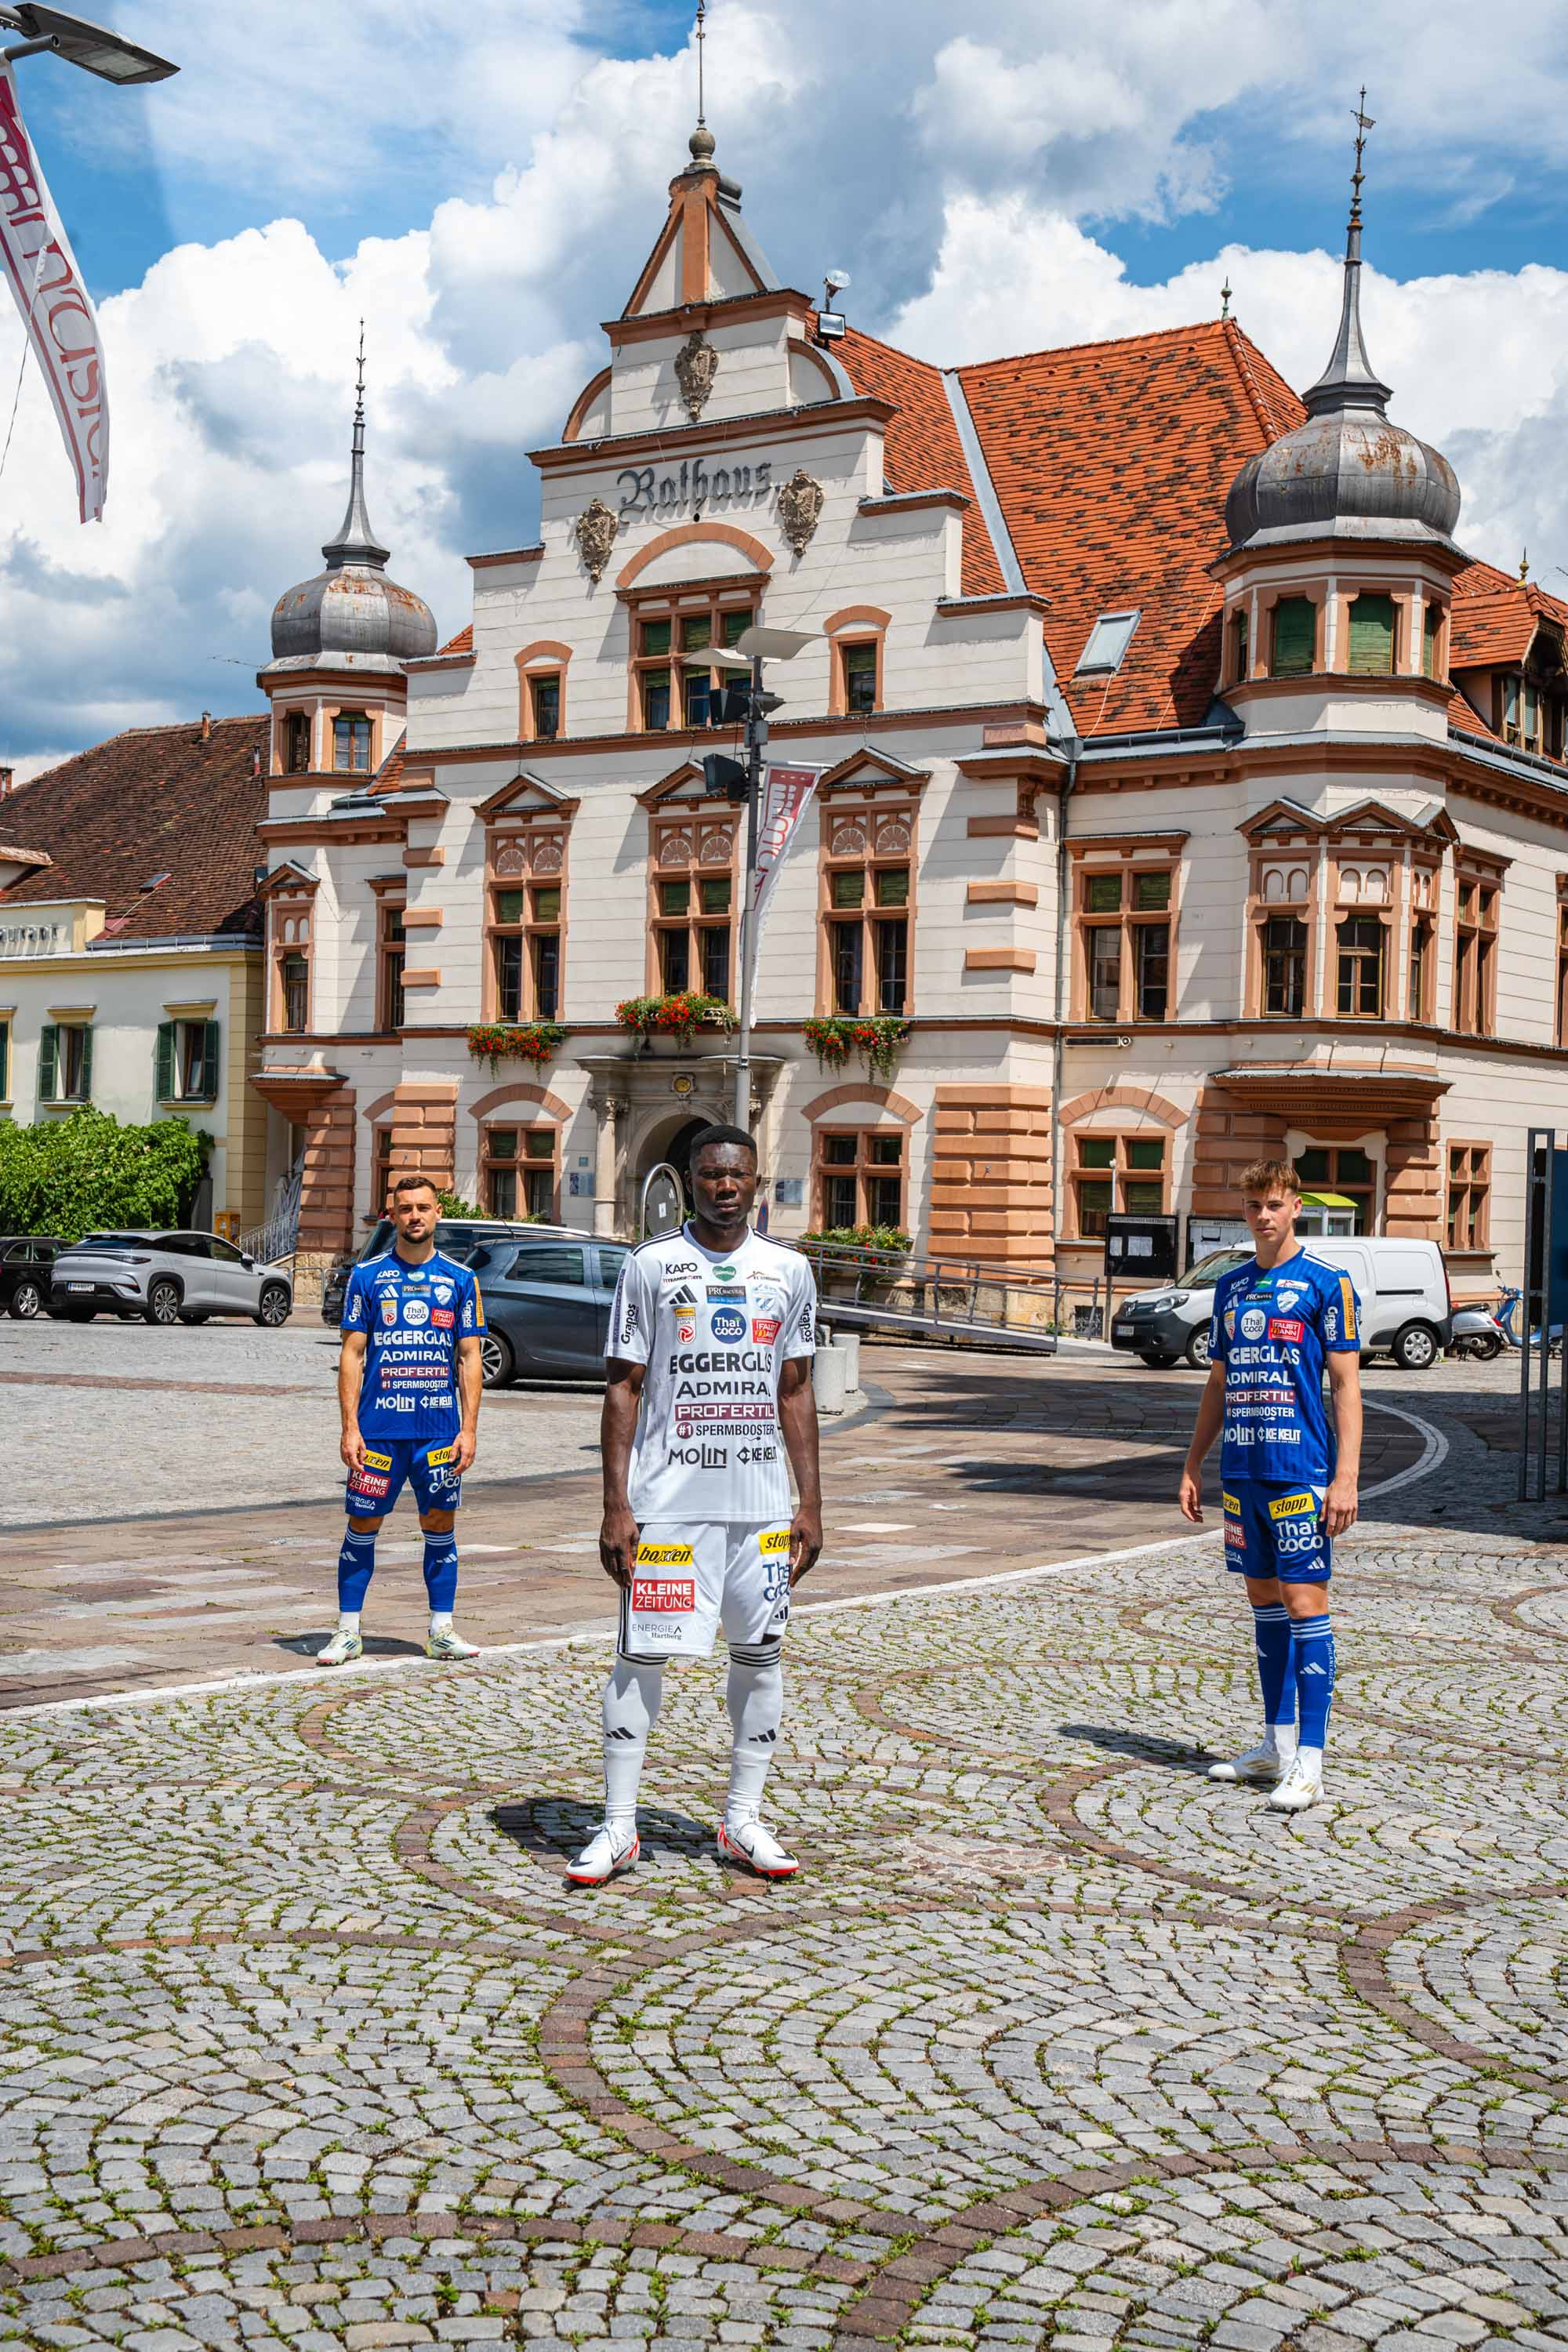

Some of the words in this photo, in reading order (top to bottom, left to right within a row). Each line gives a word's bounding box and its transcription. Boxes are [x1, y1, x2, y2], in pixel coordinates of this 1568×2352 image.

[377, 1270, 400, 1279] KAPO
[666, 1262, 698, 1274] KAPO
[798, 1303, 813, 1342] Grapos
[379, 1349, 448, 1363] ADMIRAL
[1228, 1345, 1300, 1365] GERGLAS
[382, 1380, 390, 1388] #1
[393, 1380, 448, 1389] SPERMBOOSTER
[1232, 1406, 1294, 1417] SPERMBOOSTER
[678, 1425, 692, 1436] #1
[696, 1424, 775, 1436] SPERMBOOSTER
[352, 1470, 388, 1487] KLEINE
[429, 1467, 455, 1482] Tha
[350, 1479, 386, 1496] ZEITUNG
[1275, 1497, 1308, 1514] stopp
[1276, 1519, 1318, 1537] Thai
[762, 1562, 790, 1583] Tha
[636, 1582, 692, 1595] KLEINE
[636, 1595, 692, 1609] ZEITUNG
